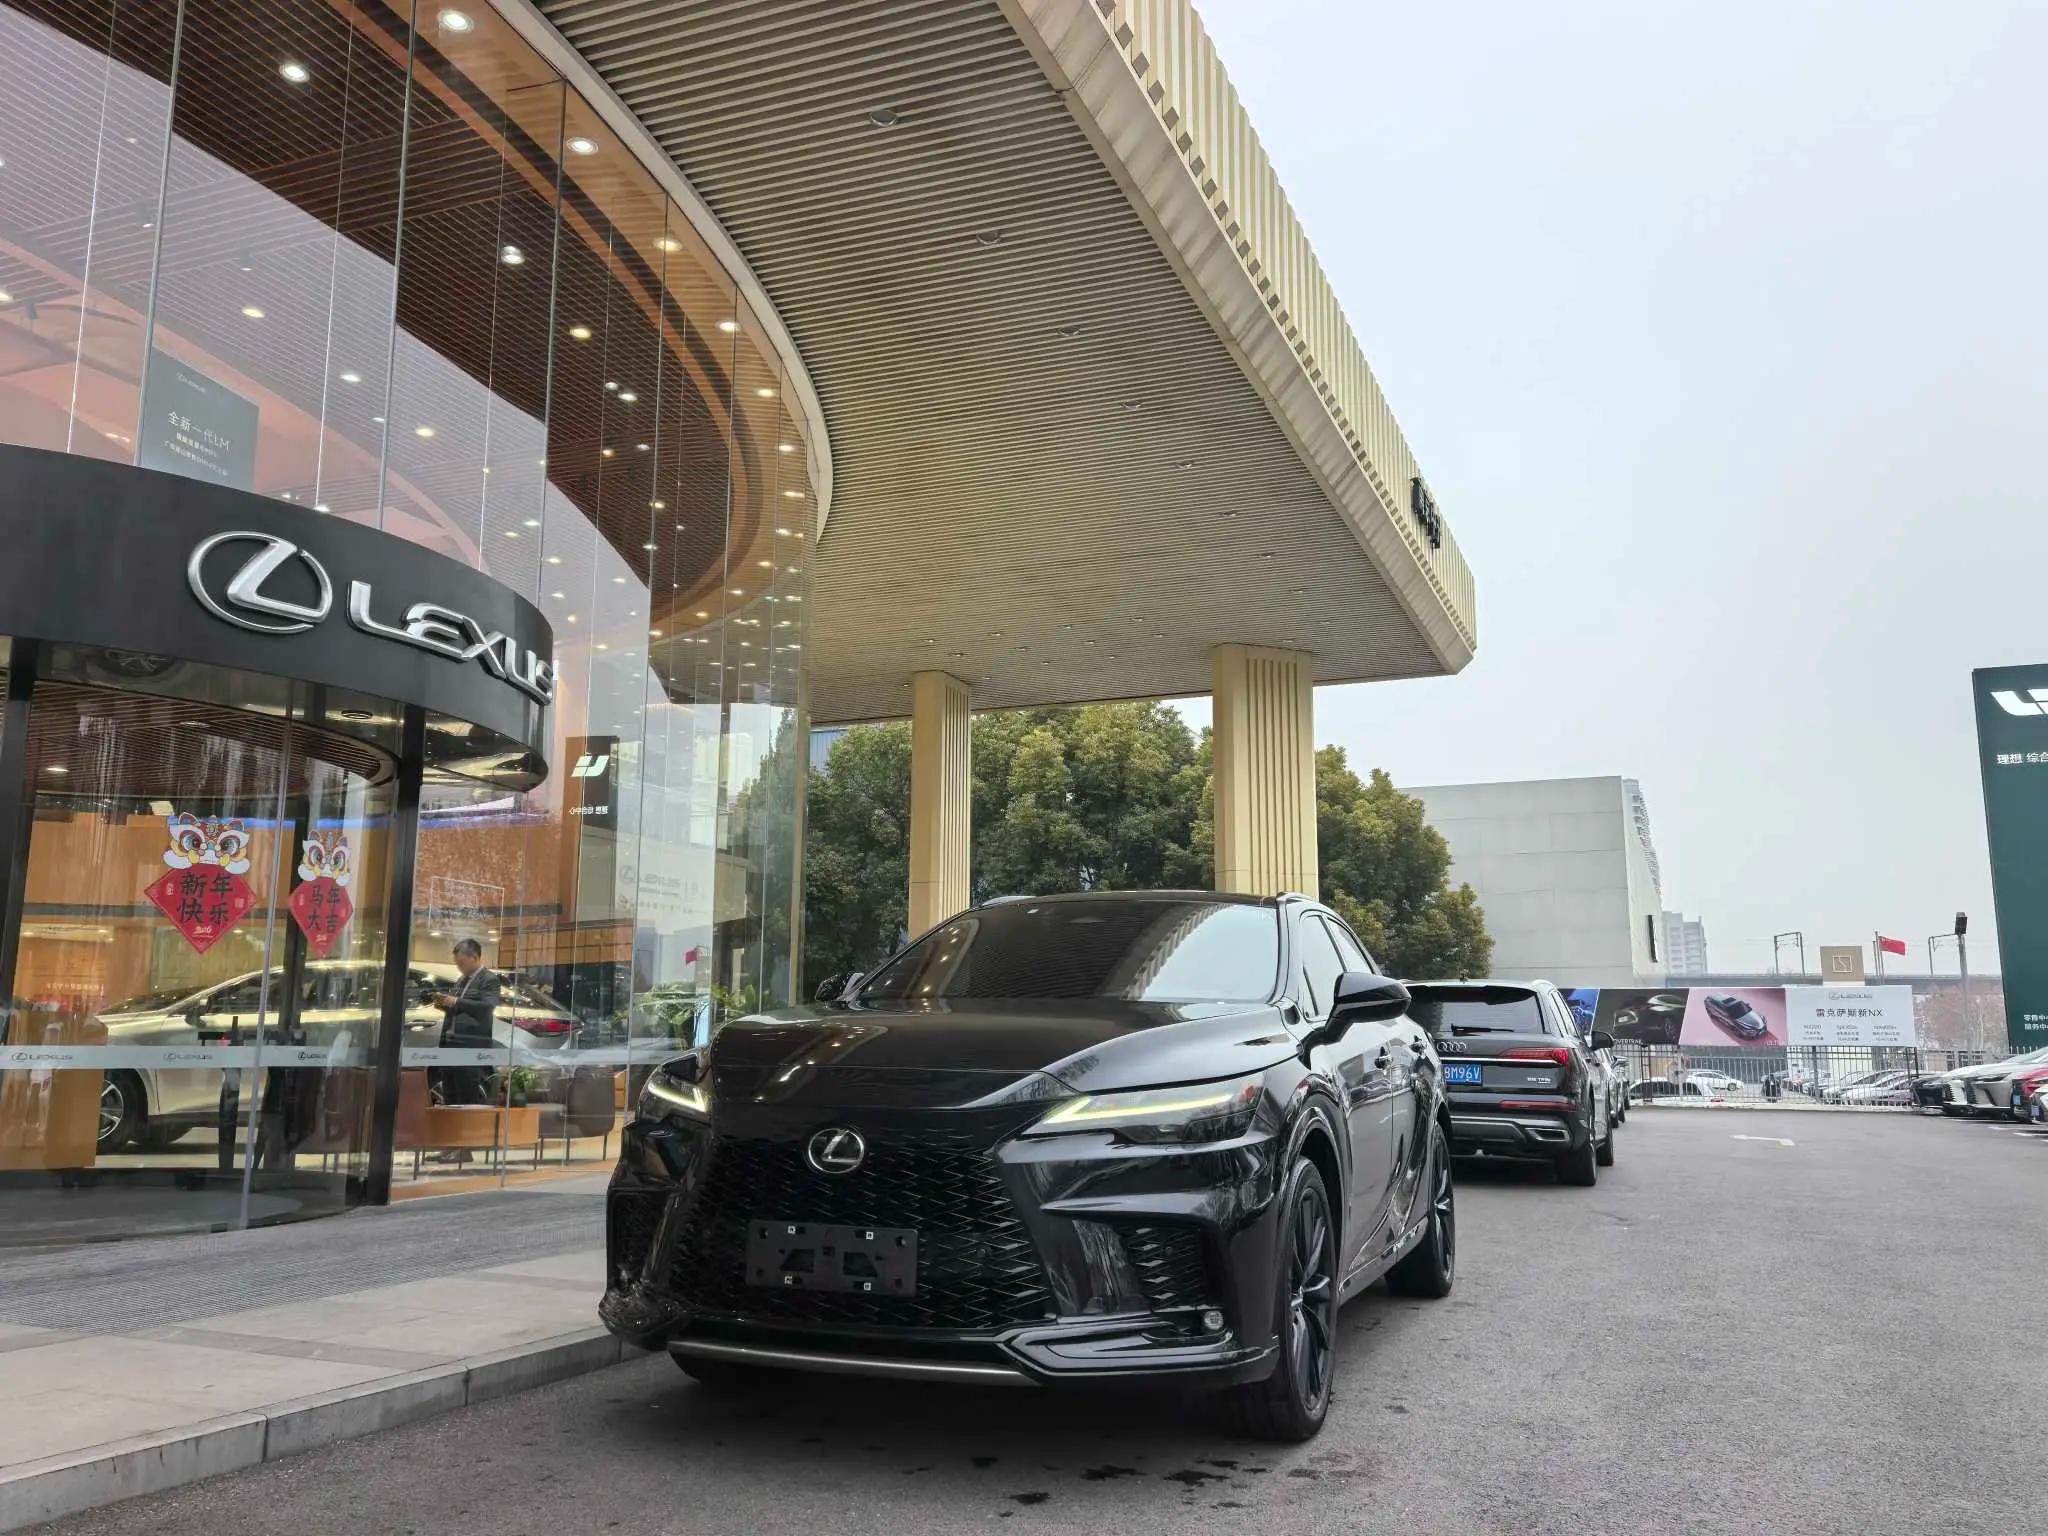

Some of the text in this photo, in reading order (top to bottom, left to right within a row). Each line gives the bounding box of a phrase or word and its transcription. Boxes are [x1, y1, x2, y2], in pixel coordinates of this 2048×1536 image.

[349, 580, 552, 706] LEXUS
[1997, 753, 2022, 765] 理想
[181, 873, 233, 898] 新年
[312, 886, 341, 912] 马年
[177, 899, 229, 926] 快乐
[308, 910, 340, 932] 大吉
[1816, 1008, 1883, 1017] 雷克萨斯新NX
[2025, 1023, 2048, 1031] 服务中
